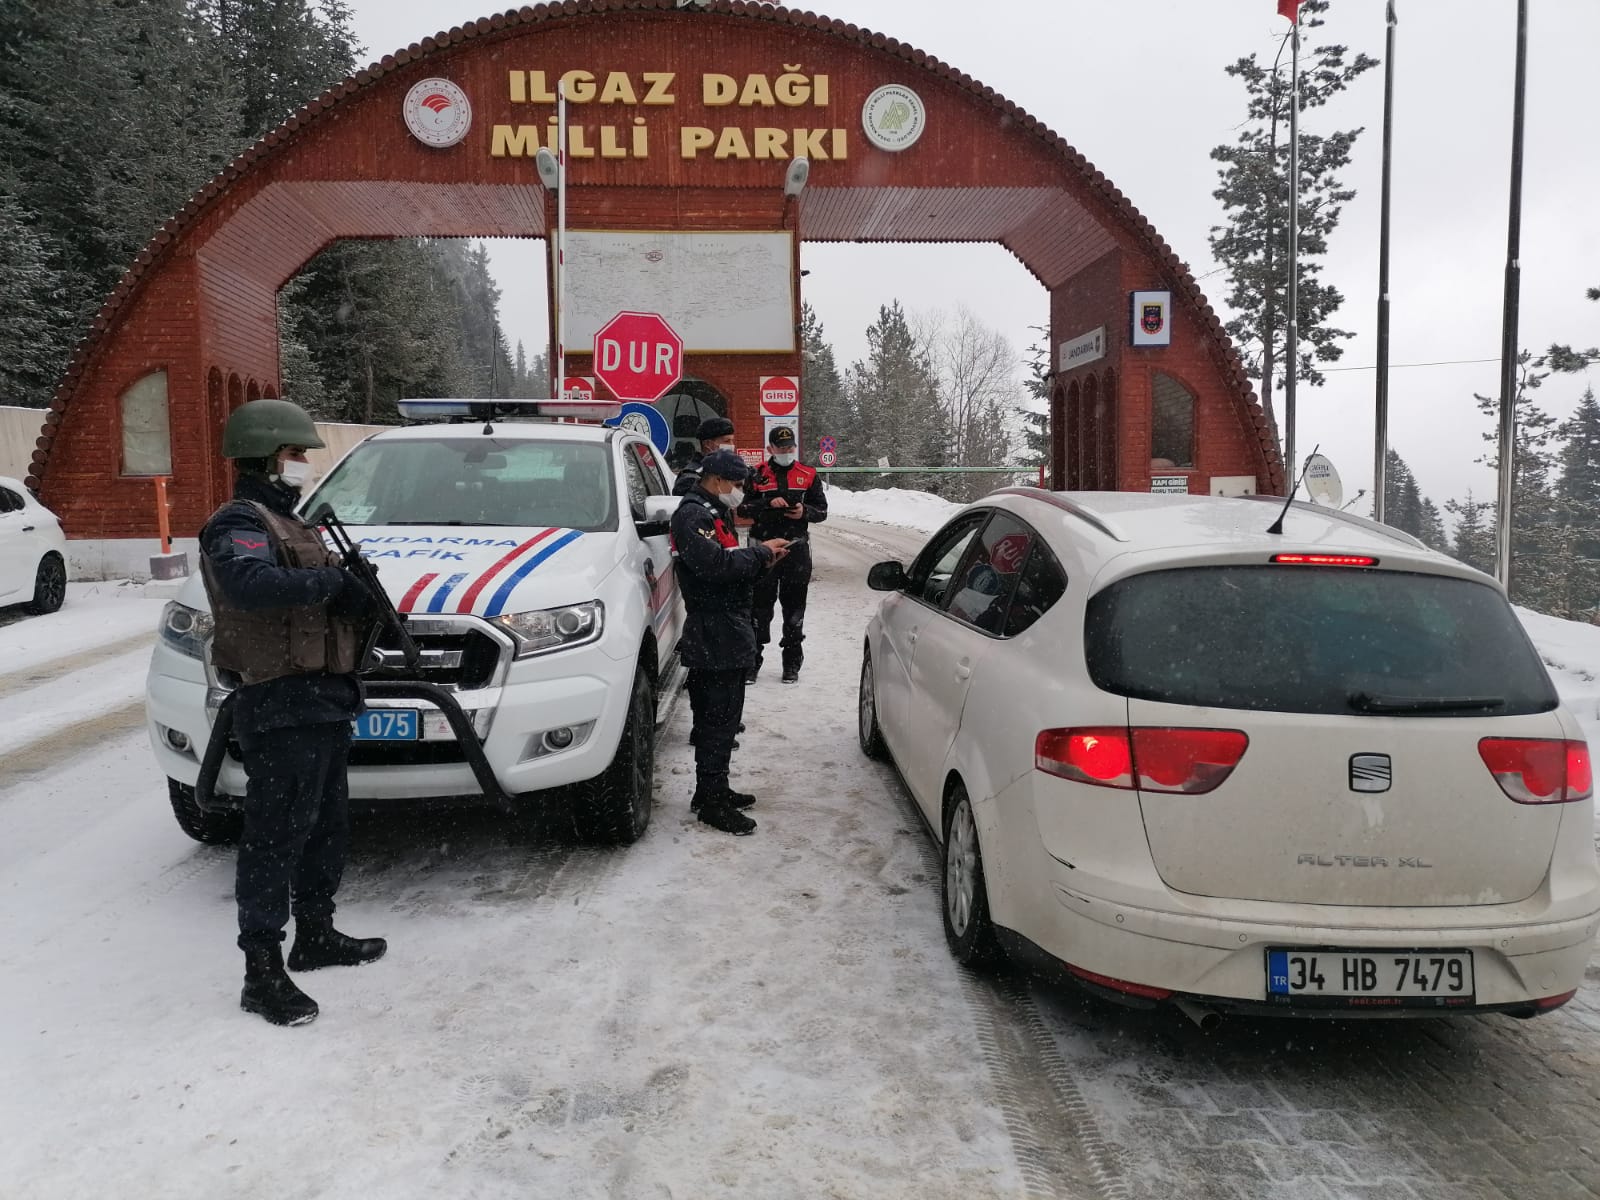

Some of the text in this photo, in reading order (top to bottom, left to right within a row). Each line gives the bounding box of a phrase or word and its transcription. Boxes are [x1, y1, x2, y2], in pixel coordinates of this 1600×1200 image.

[509, 64, 829, 106] ILGAZ DAĞI
[491, 115, 849, 160] MİLLİ PARKI
[602, 338, 674, 376] DUR
[765, 391, 794, 401] GİRİŞ
[823, 453, 833, 463] 50
[368, 713, 409, 737] 075
[1397, 855, 1433, 869] XL
[1273, 957, 1464, 992] TR 34 HB 7479
